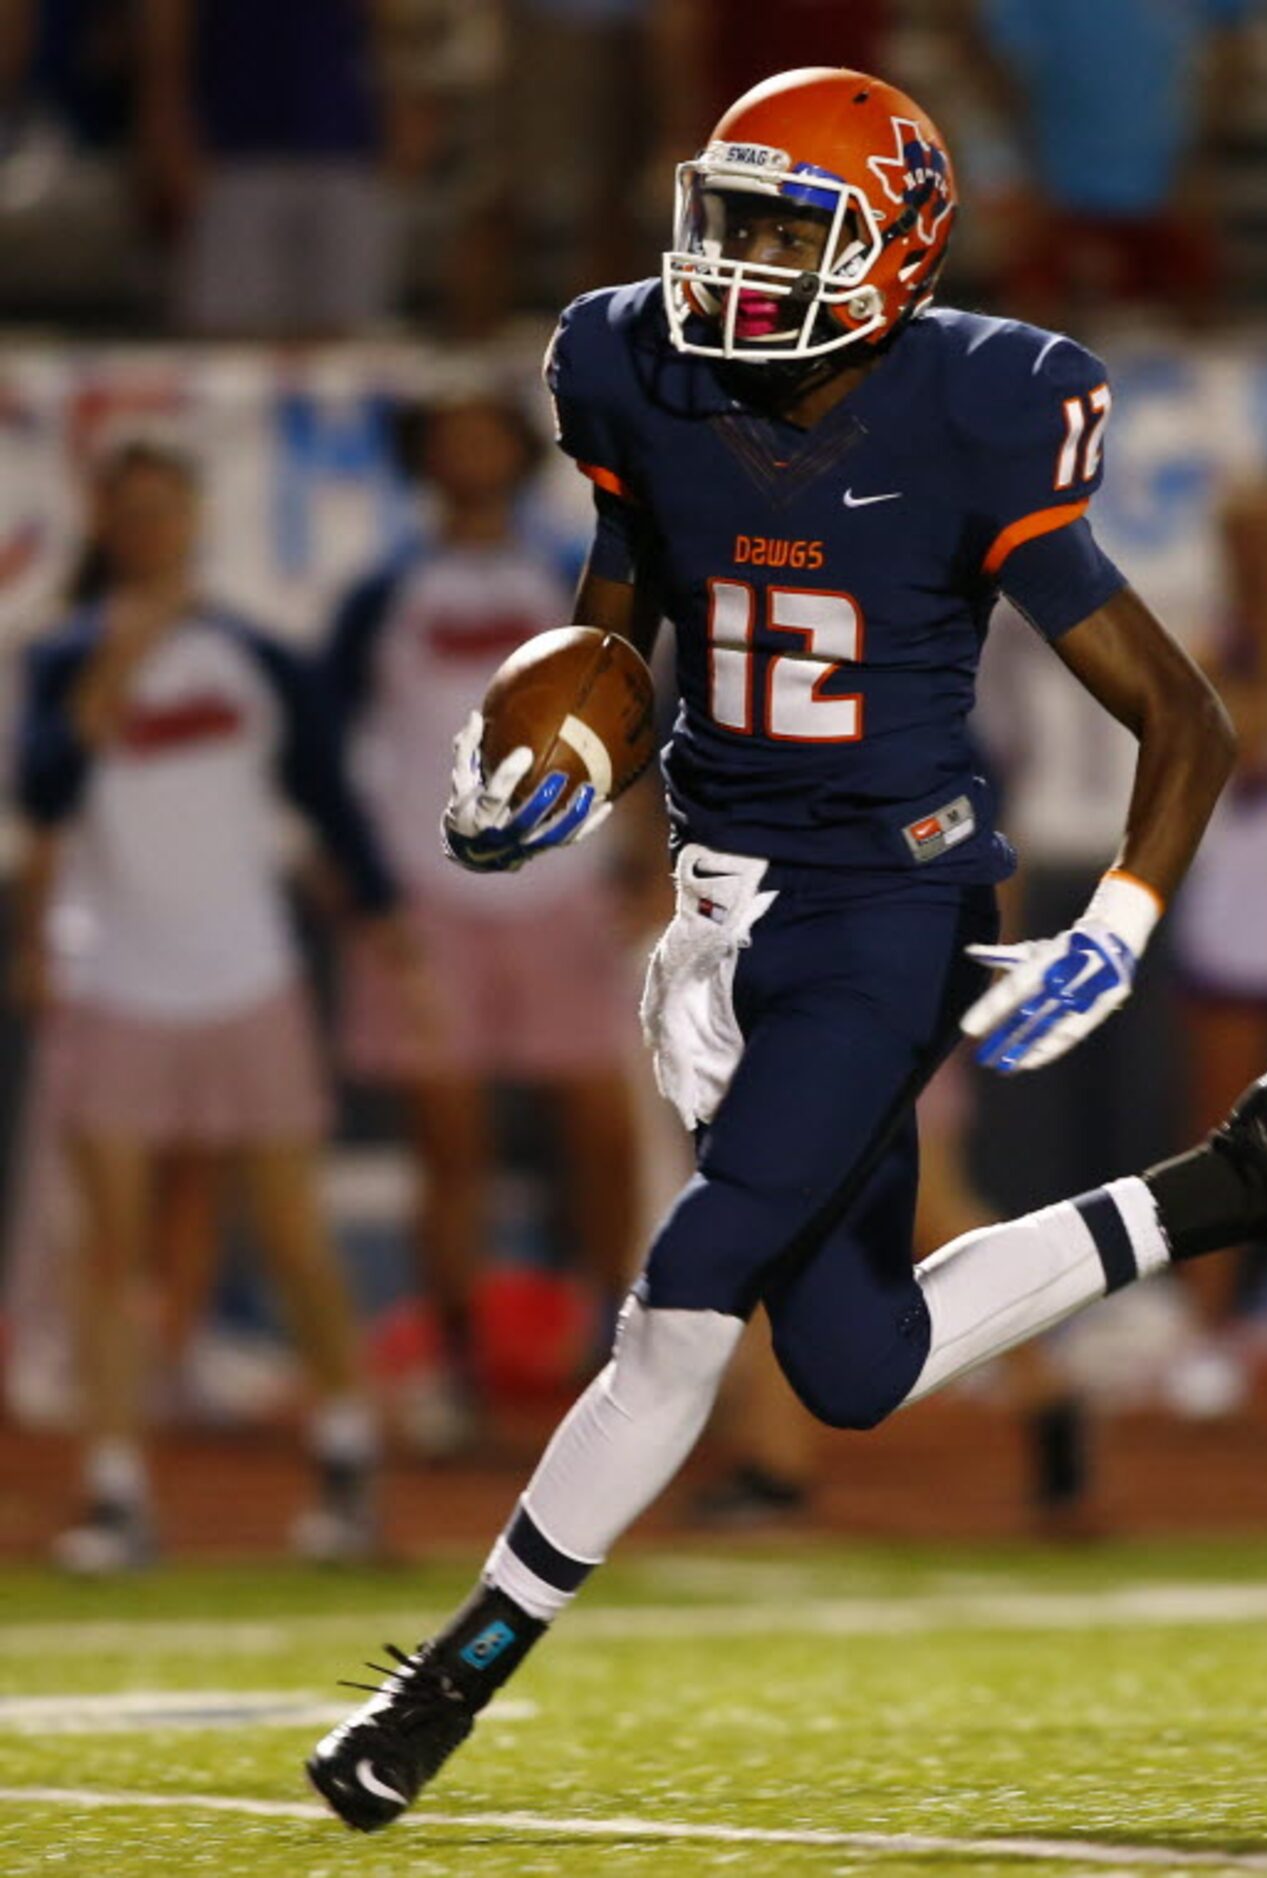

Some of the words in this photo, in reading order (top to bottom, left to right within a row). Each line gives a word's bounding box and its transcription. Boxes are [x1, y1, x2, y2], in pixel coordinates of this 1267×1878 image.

[725, 144, 769, 167] SWAG
[1053, 383, 1112, 491] 12
[707, 576, 864, 743] 12
